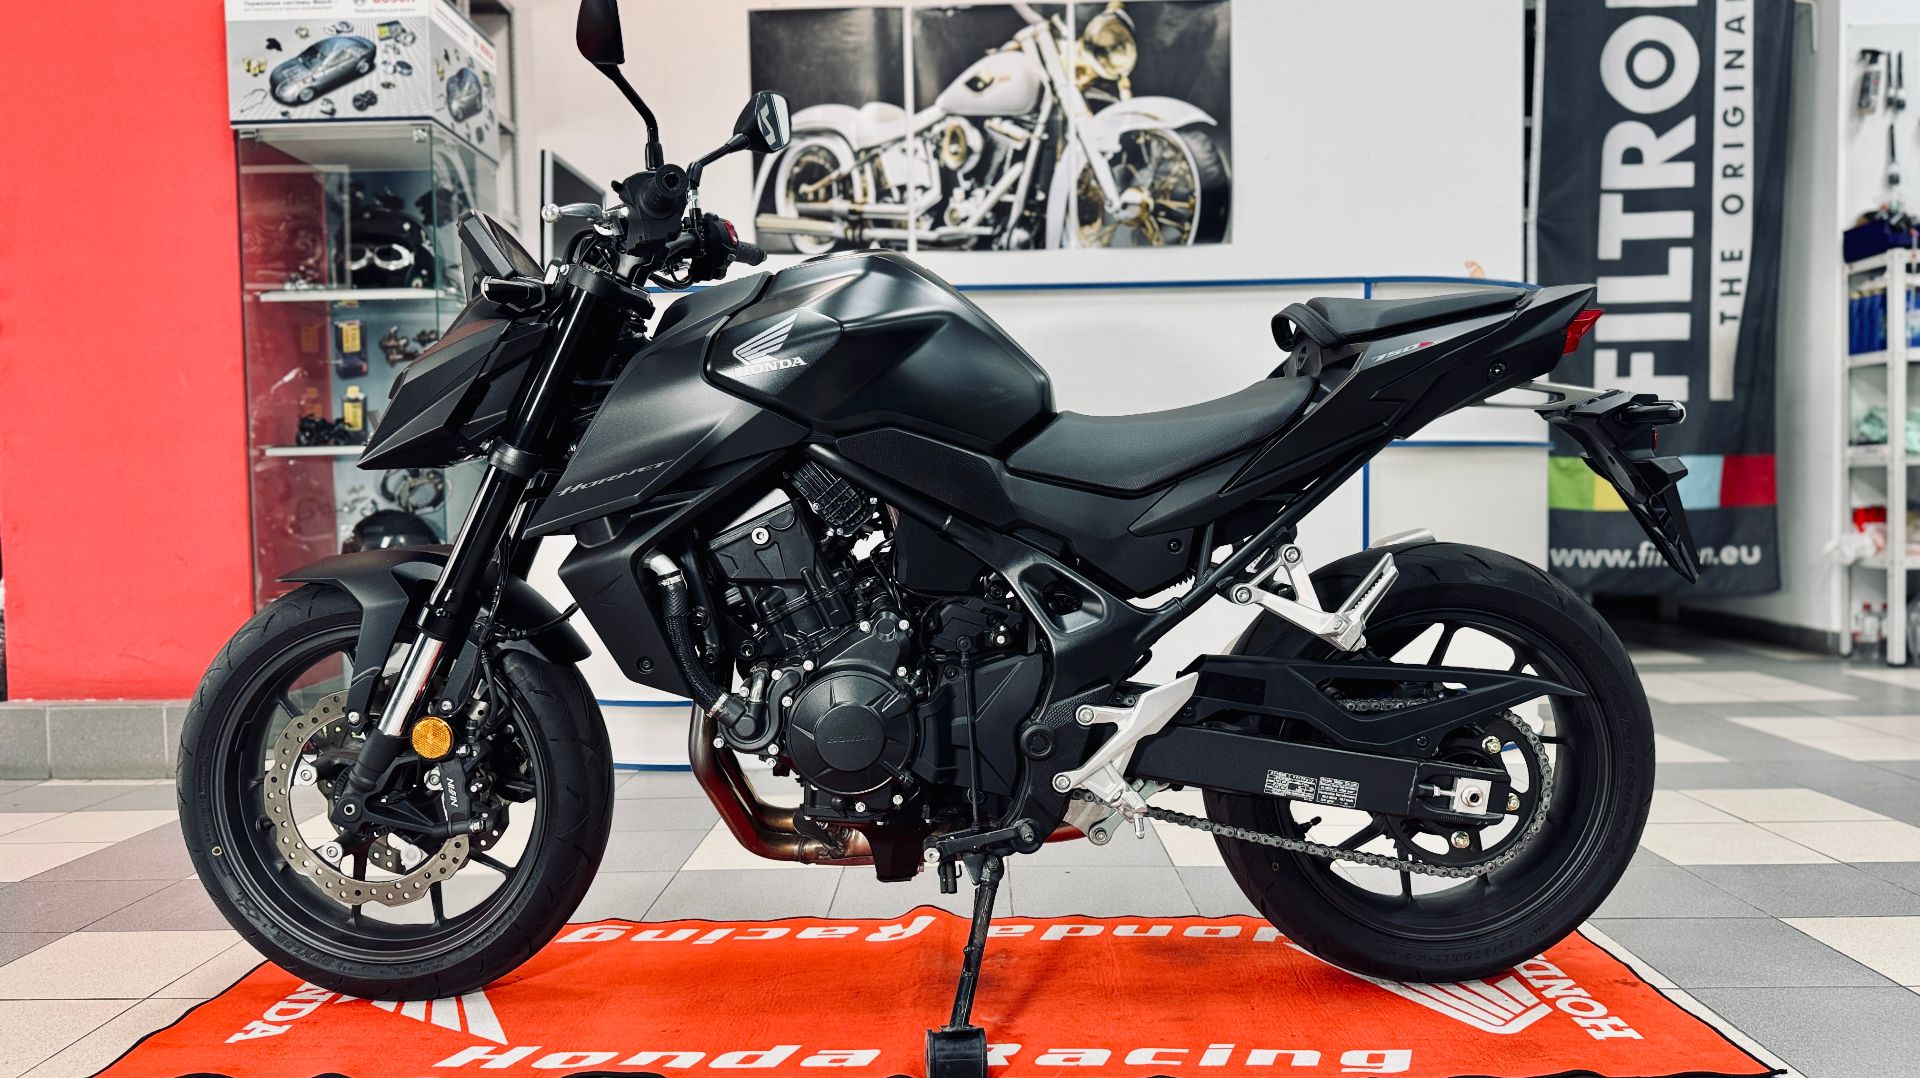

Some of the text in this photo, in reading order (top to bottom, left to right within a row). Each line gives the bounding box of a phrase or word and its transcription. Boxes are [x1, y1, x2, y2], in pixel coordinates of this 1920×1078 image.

[1719, 0, 1746, 325] THE ORIGINA
[1593, 0, 1701, 401] FILTRO
[556, 459, 673, 497] HORNET
[1550, 540, 1762, 569] www.fin.eu
[555, 915, 937, 945] Racing
[223, 981, 336, 1044] NDA
[1513, 953, 1645, 1040] HOND
[431, 1045, 882, 1070] Honda
